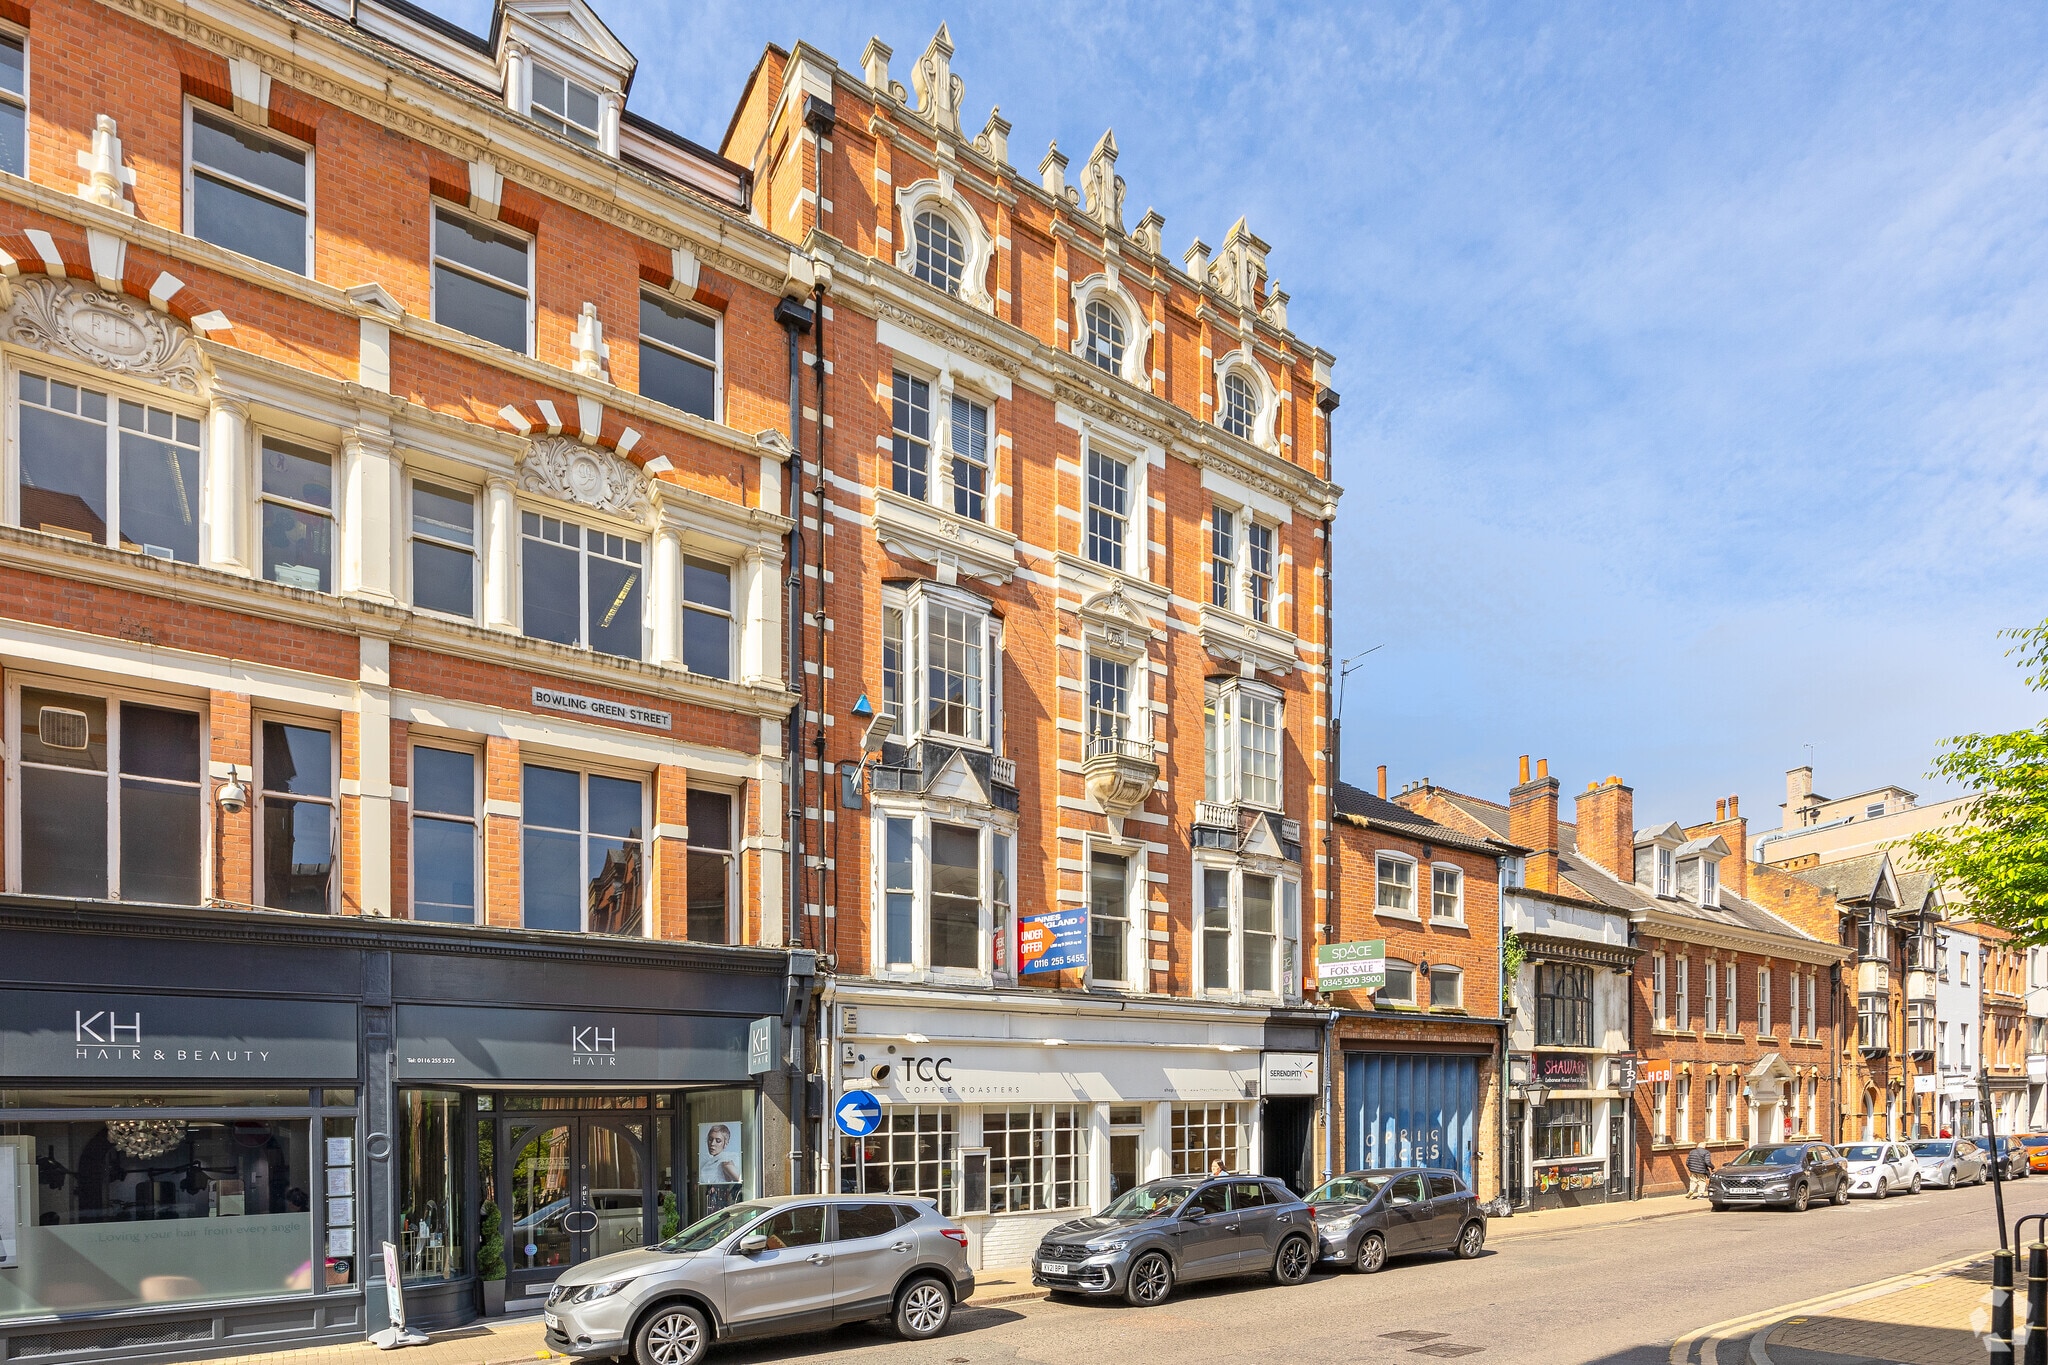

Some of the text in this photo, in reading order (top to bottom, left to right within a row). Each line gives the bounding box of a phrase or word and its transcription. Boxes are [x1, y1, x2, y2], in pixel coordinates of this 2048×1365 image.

[536, 691, 668, 725] BOWLING GREEN STREET
[1021, 929, 1043, 941] UNDER
[1021, 942, 1043, 954] OFFER
[1034, 954, 1084, 968] 0116 255 5455
[1330, 964, 1374, 976] FOR SALE
[1322, 979, 1343, 987] 0345
[1344, 977, 1359, 985] 900
[1361, 975, 1381, 984] 3900
[75, 1010, 140, 1043] KH
[572, 1025, 615, 1052] KH
[752, 1026, 768, 1054] KH
[76, 1049, 269, 1062] HAIR & BEAUTY
[573, 1056, 616, 1066] HAIR
[901, 1057, 952, 1082] TCC
[1269, 1069, 1303, 1077] SERENDIPITY
[1648, 1070, 1670, 1082] HCB
[143, 1230, 171, 1242] your
[176, 1228, 198, 1238] hair
[204, 1226, 232, 1237] from
[236, 1225, 268, 1235] every
[271, 1222, 300, 1233] angle
